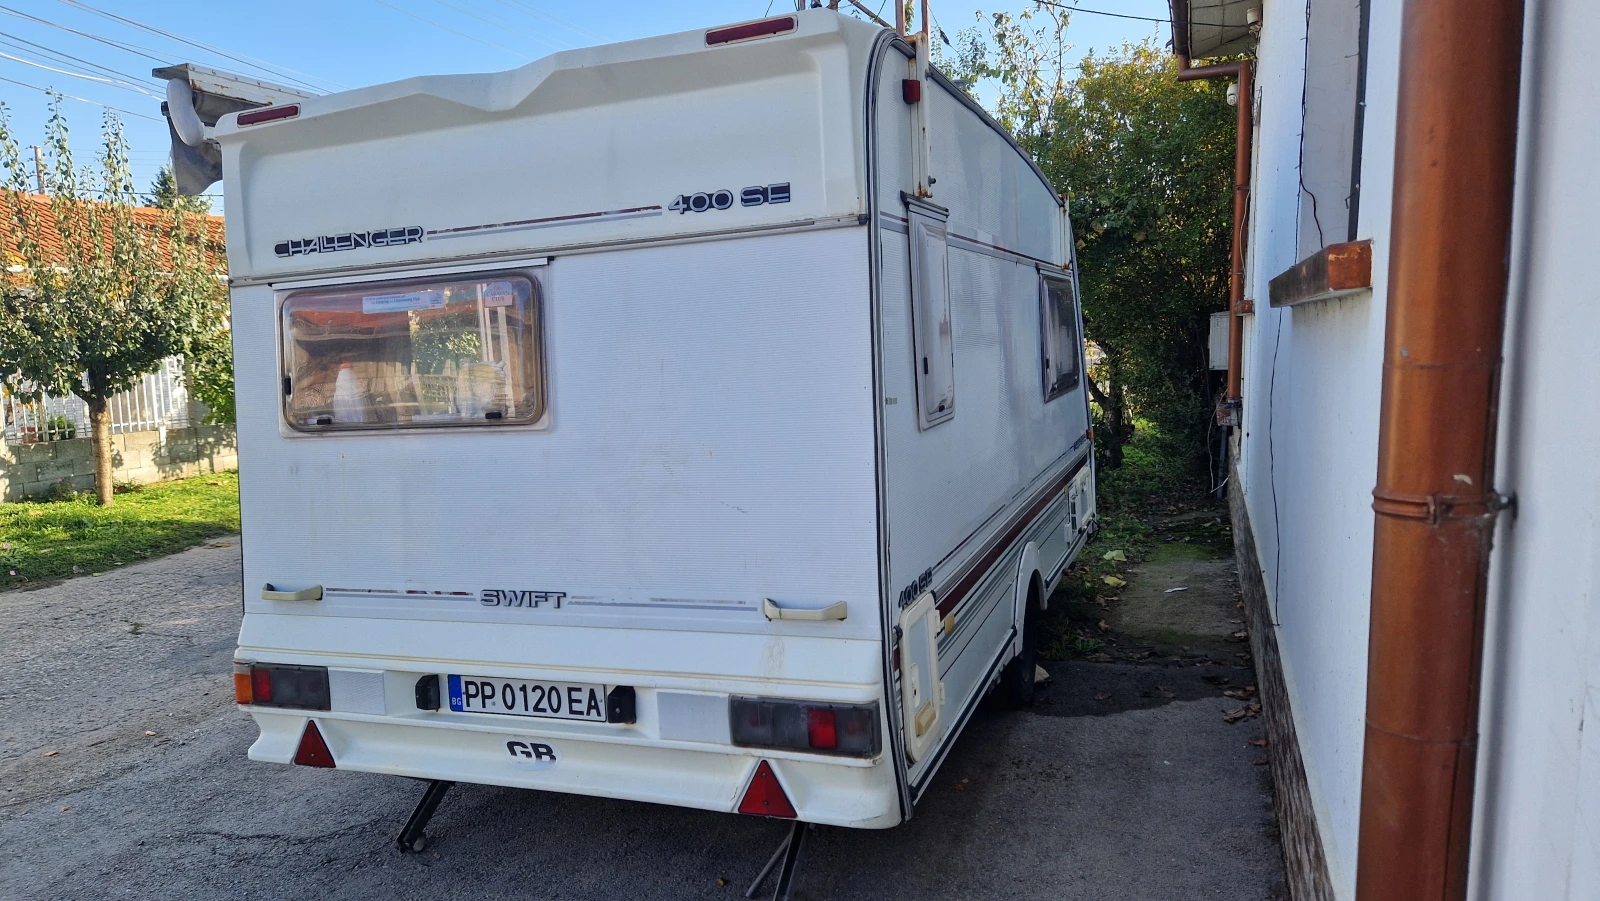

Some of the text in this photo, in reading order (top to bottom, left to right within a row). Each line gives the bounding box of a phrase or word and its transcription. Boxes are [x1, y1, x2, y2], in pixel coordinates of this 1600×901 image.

[668, 182, 790, 214] 400 SE
[274, 226, 423, 258] CHALLENGER
[480, 589, 567, 609] SWIFT
[898, 580, 919, 610] 400
[451, 697, 462, 706] BG
[463, 681, 602, 717] PP 0120 EA
[506, 741, 557, 762] GB
